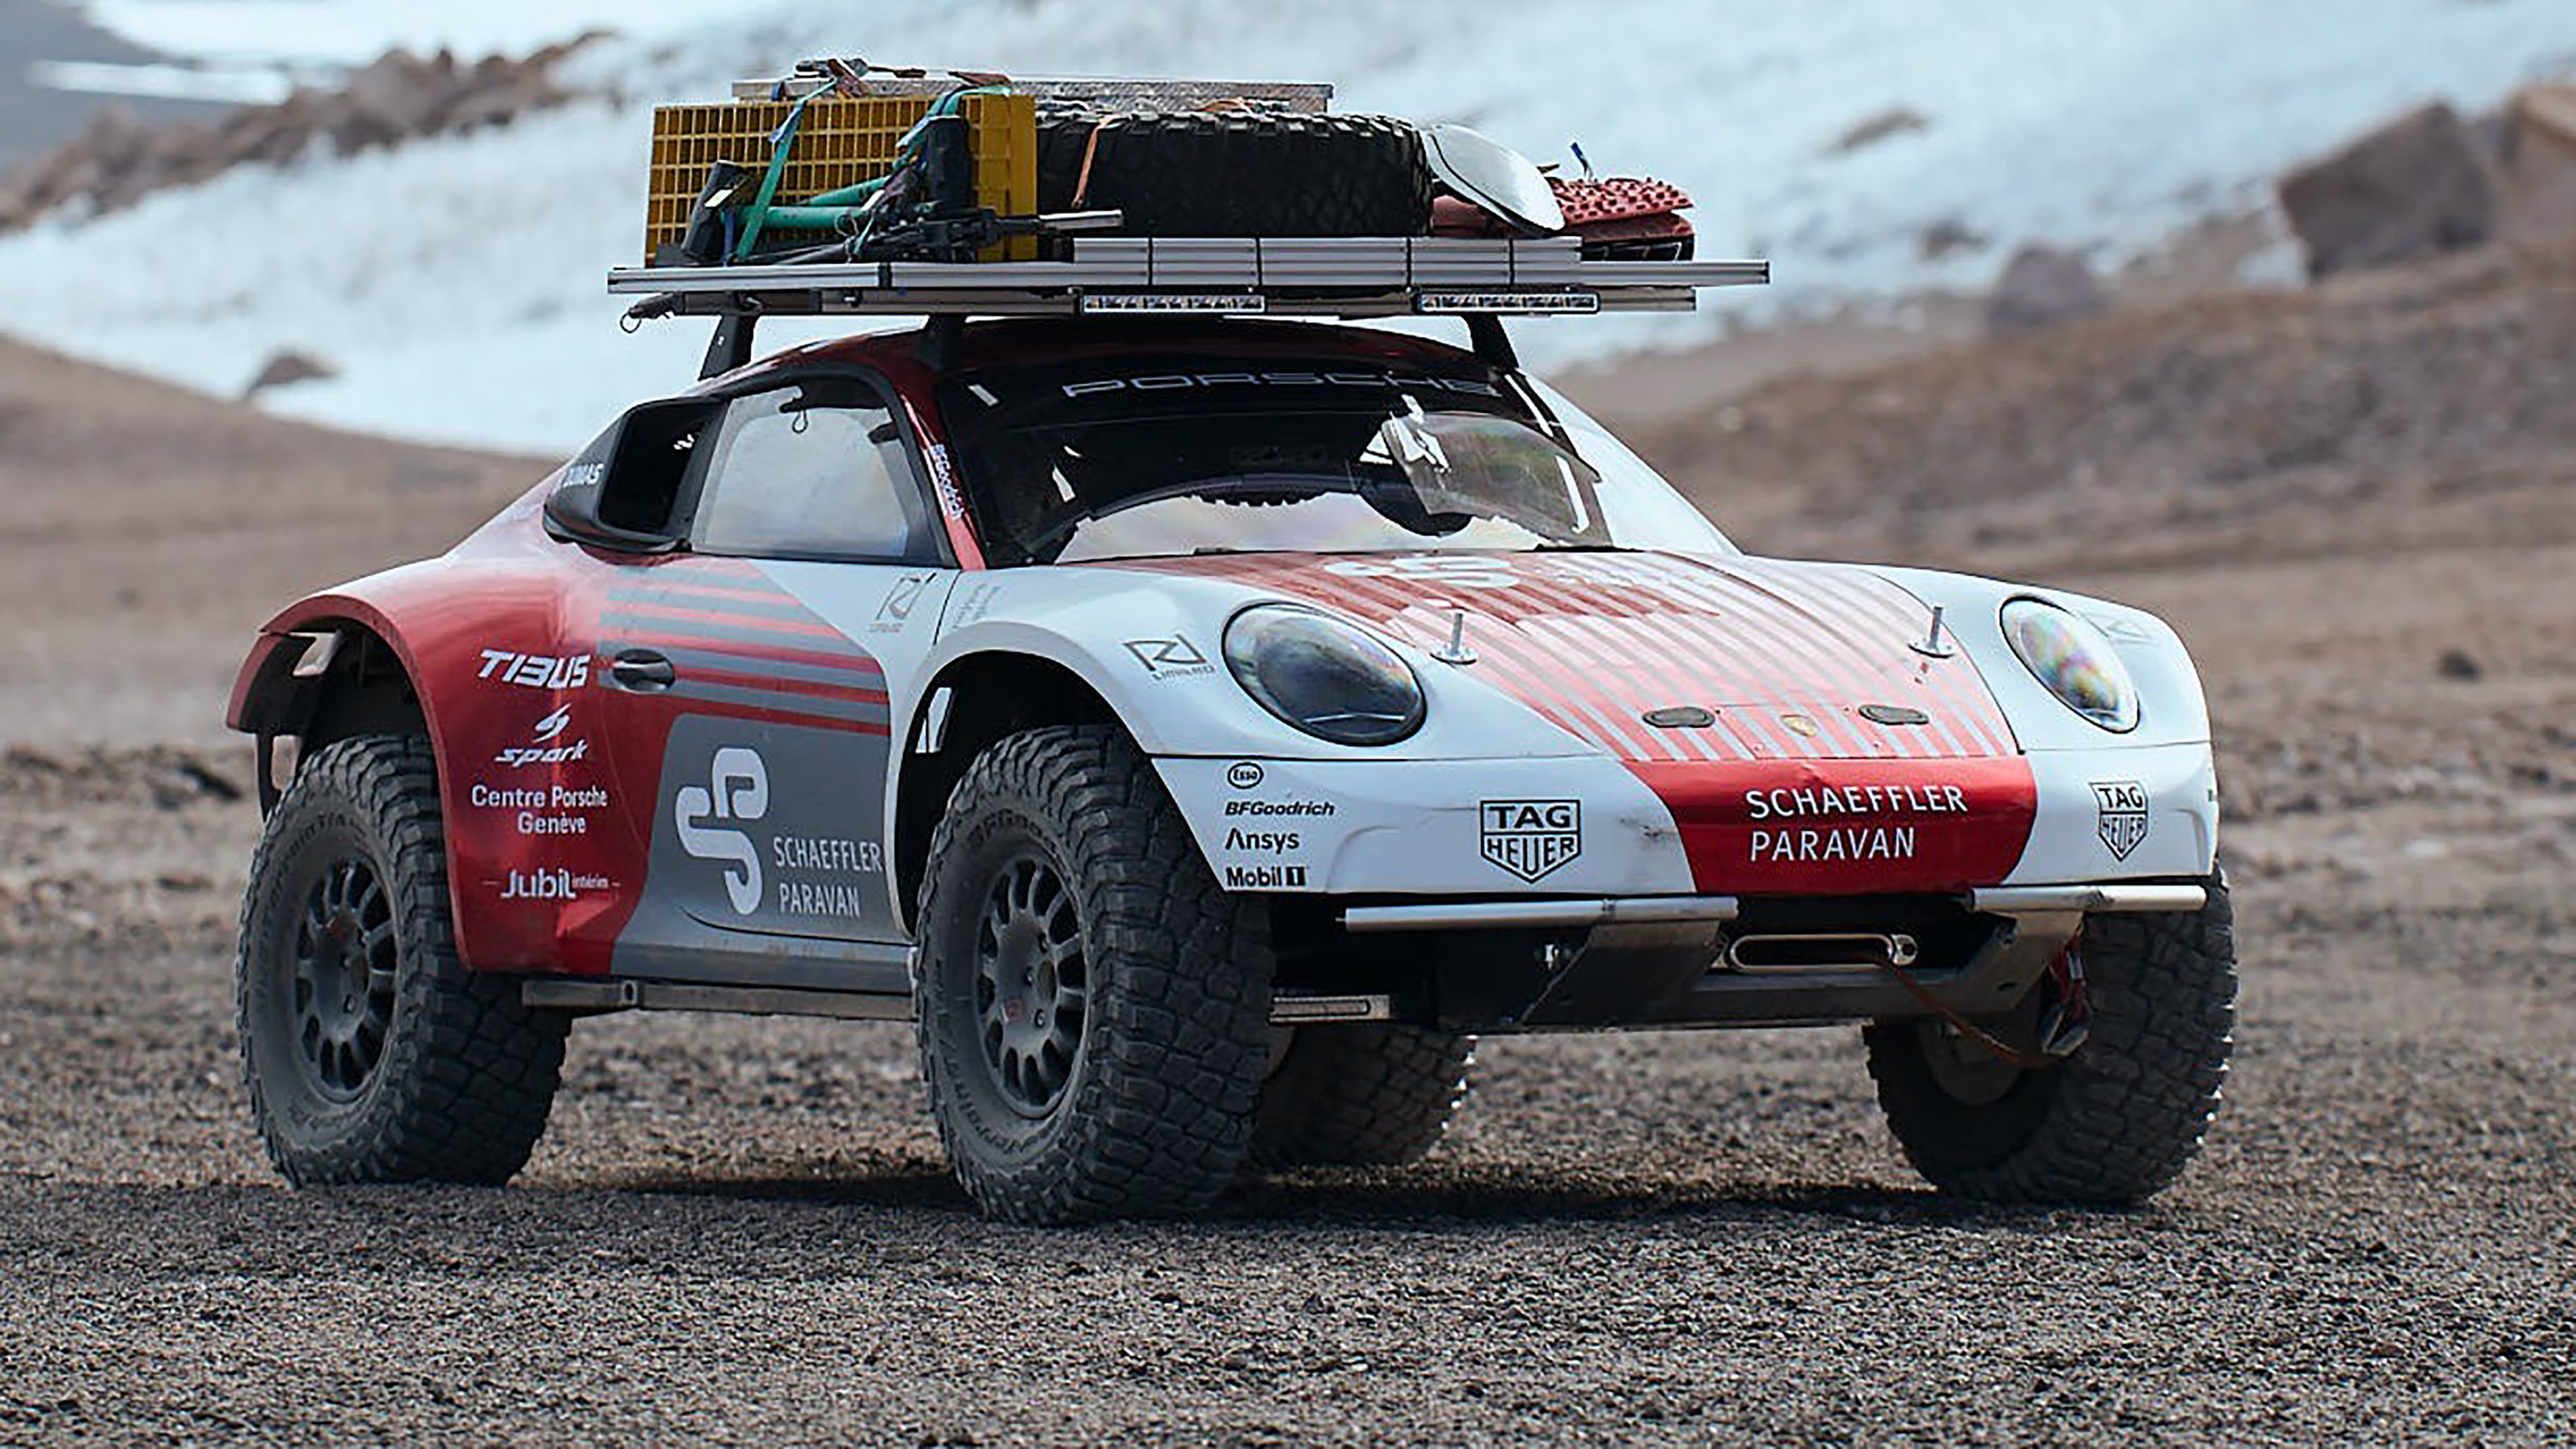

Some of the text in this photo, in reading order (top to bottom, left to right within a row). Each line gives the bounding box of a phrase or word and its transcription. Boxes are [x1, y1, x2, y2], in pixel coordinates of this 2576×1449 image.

[1063, 372, 1502, 398] PORSCHE
[478, 649, 589, 689] TIBUS
[494, 739, 588, 767] spark
[472, 784, 608, 808] Centre Porsche
[1225, 801, 1335, 816] BFGoodrich
[1745, 785, 1967, 819] SCHAEFFLER
[2098, 786, 2143, 808] TAG
[517, 811, 586, 834] Genève
[1489, 805, 1571, 828] TAG
[1225, 828, 1299, 855] Ansys
[1750, 827, 1914, 861] PARAVAN
[2101, 815, 2145, 853] HEUER
[773, 836, 883, 873] SCHAEFFLER
[1487, 836, 1575, 875] HEUER
[501, 867, 577, 899] Jubil
[1226, 866, 1282, 886] Mobil
[779, 883, 860, 916] PARAVAN
